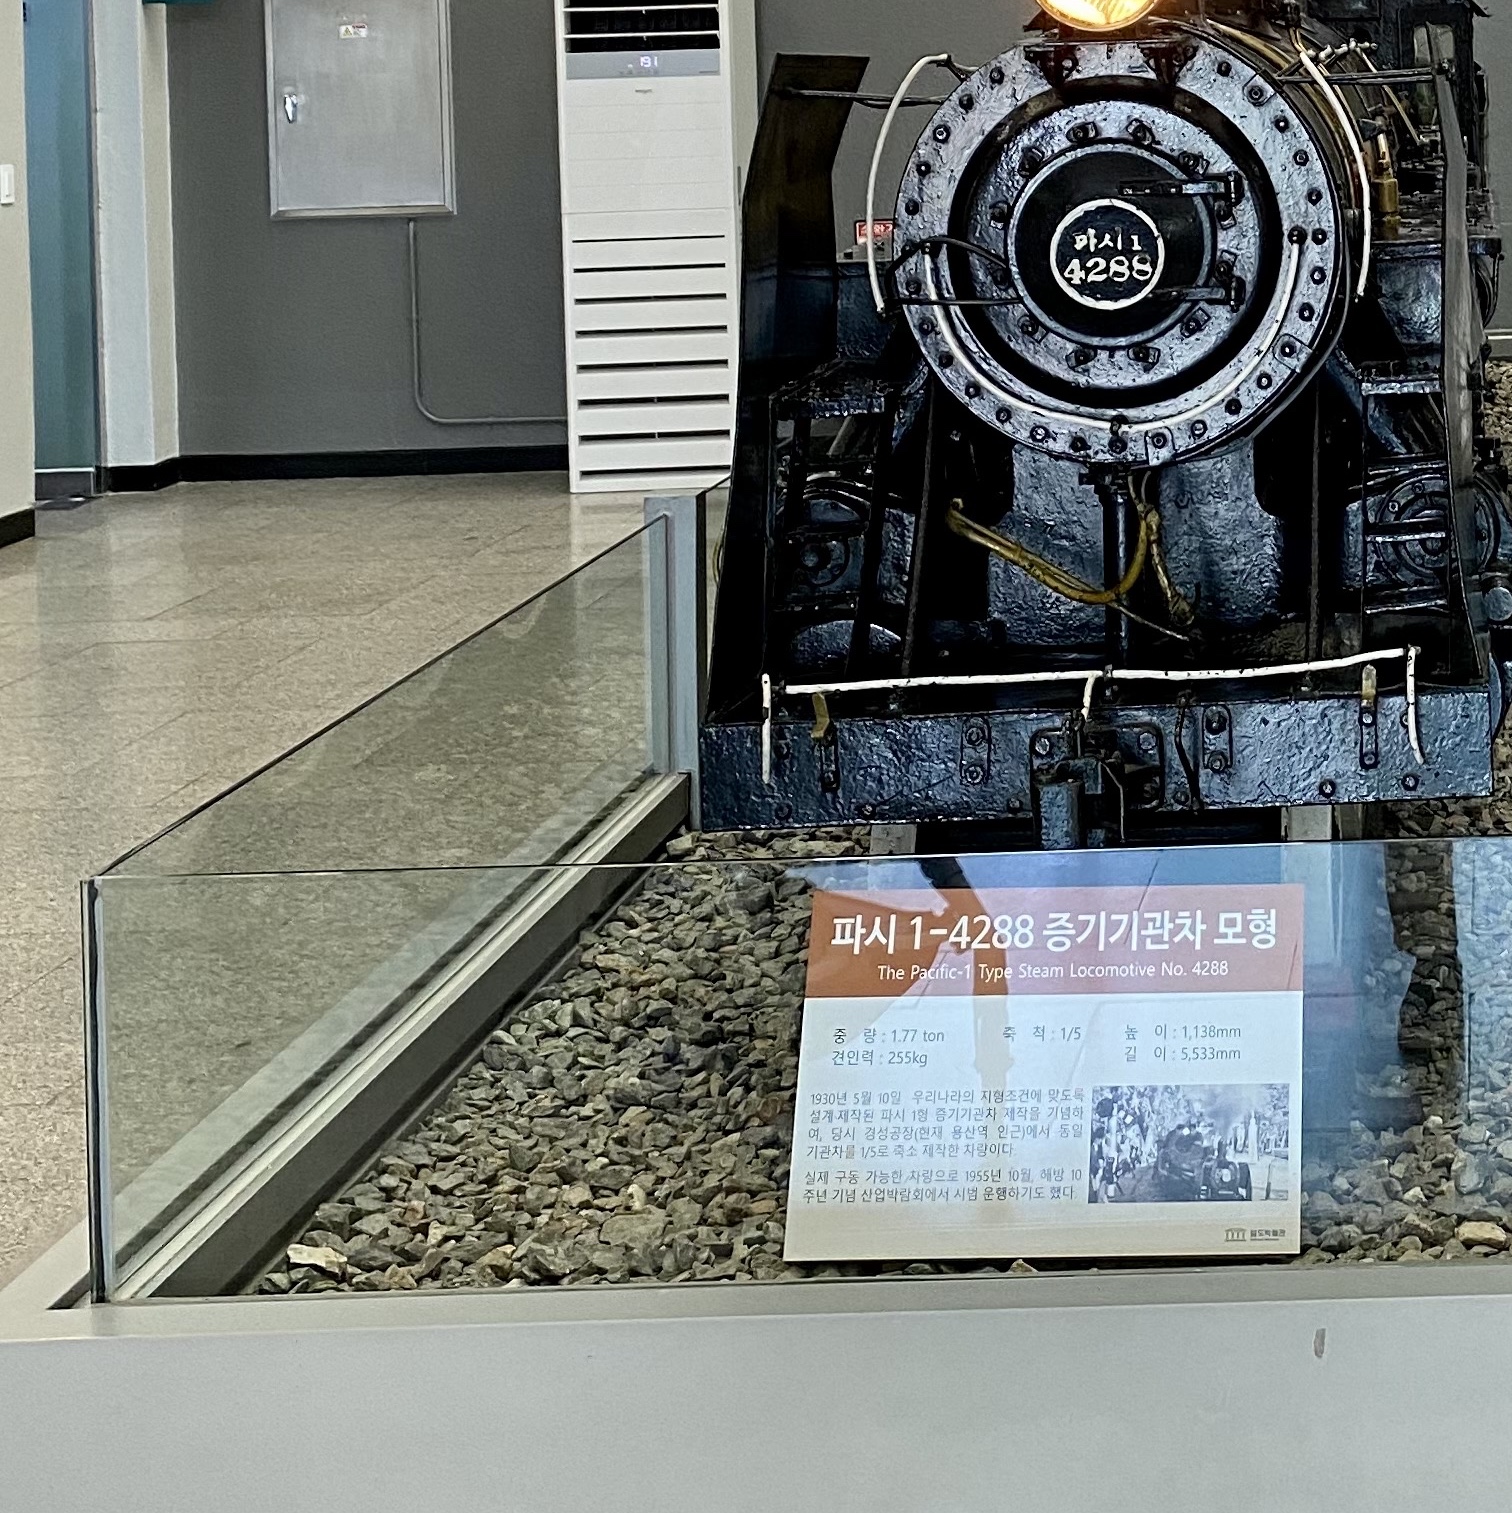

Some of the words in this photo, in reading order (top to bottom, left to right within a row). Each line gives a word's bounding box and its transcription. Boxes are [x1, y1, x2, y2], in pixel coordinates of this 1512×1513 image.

[1063, 253, 1153, 285] 4288
[830, 913, 896, 956] 파시
[910, 913, 1034, 951] 1-4288
[1042, 909, 1207, 953] 증기기관차
[1213, 908, 1277, 950] 모형
[878, 965, 905, 980] The
[911, 963, 971, 980] Pacific-1
[979, 963, 1013, 983] Type
[1018, 963, 1064, 978] Steam
[1070, 960, 1156, 978] Locomotive
[1161, 961, 1187, 976] No.
[1192, 960, 1228, 976] 4288
[891, 1029, 918, 1043] 1.77
[923, 1029, 945, 1043] ton
[1060, 1026, 1081, 1042] 1/5
[1181, 1024, 1241, 1040] 1,138mm
[832, 1049, 874, 1066] 견인력
[888, 1050, 928, 1067] 255kg
[1181, 1046, 1241, 1063] 5,533mm
[811, 1091, 847, 1106] 1930년
[853, 1091, 872, 1106] 5월
[878, 1090, 901, 1105] 10일
[912, 1090, 974, 1104] 우리나라의
[981, 1088, 1042, 1104] 지형조건에
[881, 1108, 905, 1123] 파시
[935, 1107, 997, 1123] 증기기관차
[1004, 1106, 1041, 1121] 제작을
[831, 1126, 855, 1141] 당시
[951, 1124, 988, 1140] 용산역
[1058, 1123, 1083, 1138] 동일
[861, 1144, 889, 1159] 1/5로
[893, 1144, 917, 1158] 축소
[922, 1143, 959, 1158] 제작한
[804, 1170, 829, 1185] 실제
[835, 1170, 859, 1185] 구동
[865, 1169, 902, 1185] 가능한
[965, 1168, 1001, 1183] 1955년
[1040, 1168, 1064, 1183] 해방
[1071, 1168, 1082, 1182] 10
[803, 1189, 827, 1204] 주년
[832, 1188, 856, 1203] 기념
[861, 1187, 949, 1204] 산업박람회에서
[954, 1186, 978, 1201] 시범
[983, 1186, 1045, 1201] 운행하기도
